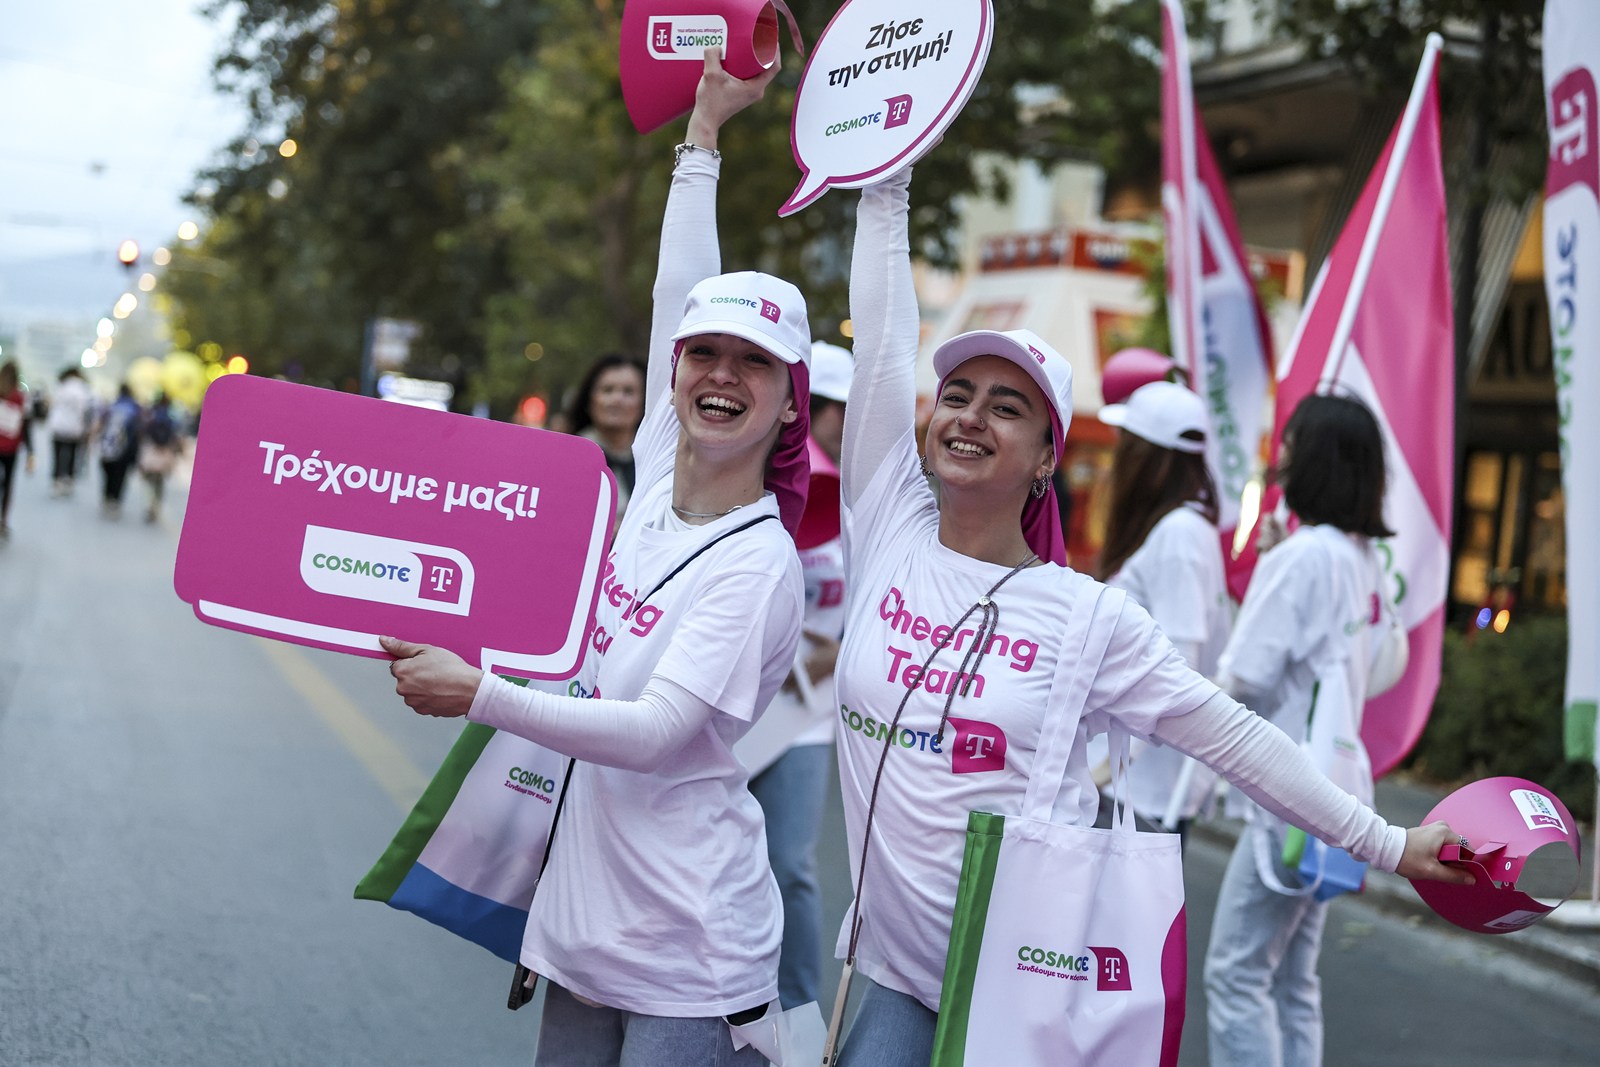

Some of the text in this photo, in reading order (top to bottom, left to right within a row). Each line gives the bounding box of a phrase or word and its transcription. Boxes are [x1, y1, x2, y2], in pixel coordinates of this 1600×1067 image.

[676, 35, 723, 46] COSMOTE
[865, 17, 924, 50] Ζήσε
[828, 29, 953, 88] την στιγμή!
[825, 111, 882, 137] COSMOTE
[710, 296, 758, 309] COSMOTE
[258, 440, 541, 522] Τρέχουμε μαζί!
[311, 552, 411, 583] COSMOTE
[879, 586, 1040, 673] Cheering
[886, 645, 986, 698] Team
[840, 703, 945, 754] COSMOTE
